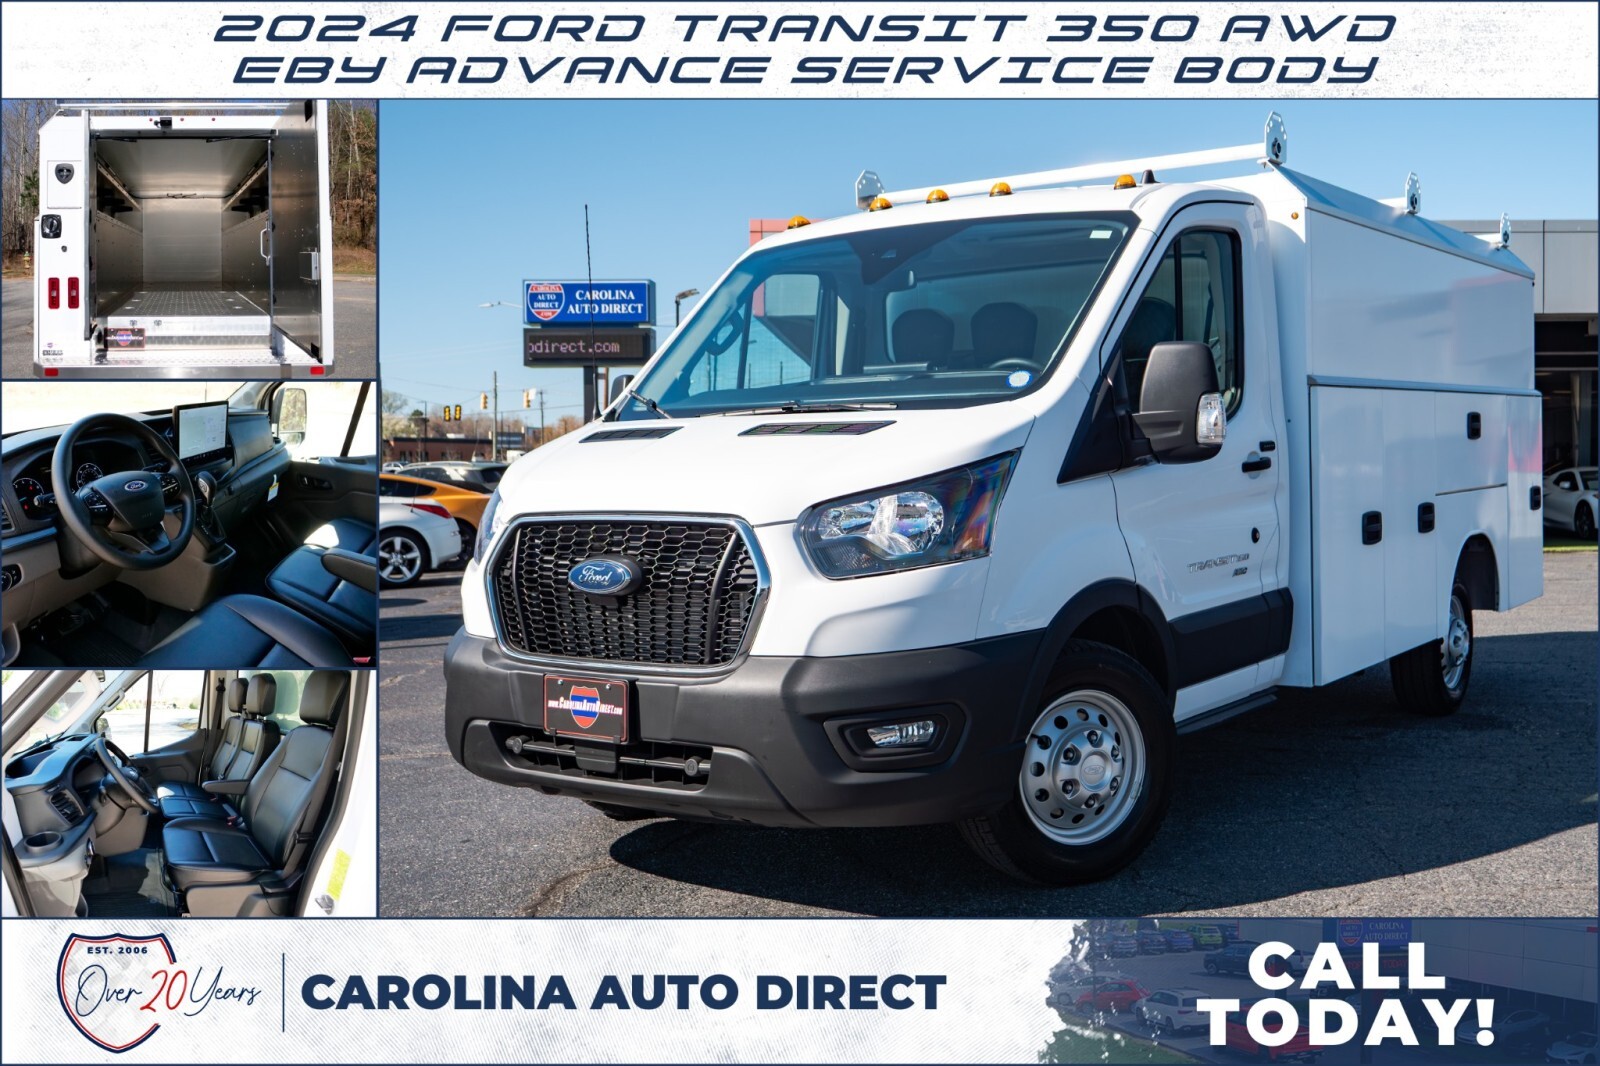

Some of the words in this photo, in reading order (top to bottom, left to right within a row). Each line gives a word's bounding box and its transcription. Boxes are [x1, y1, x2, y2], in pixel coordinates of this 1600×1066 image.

[575, 290, 635, 300] CAROLINA
[567, 304, 599, 314] AUTO
[600, 303, 643, 314] DIRECT
[578, 565, 613, 583] Ford
[1369, 922, 1405, 930] CAROLINA
